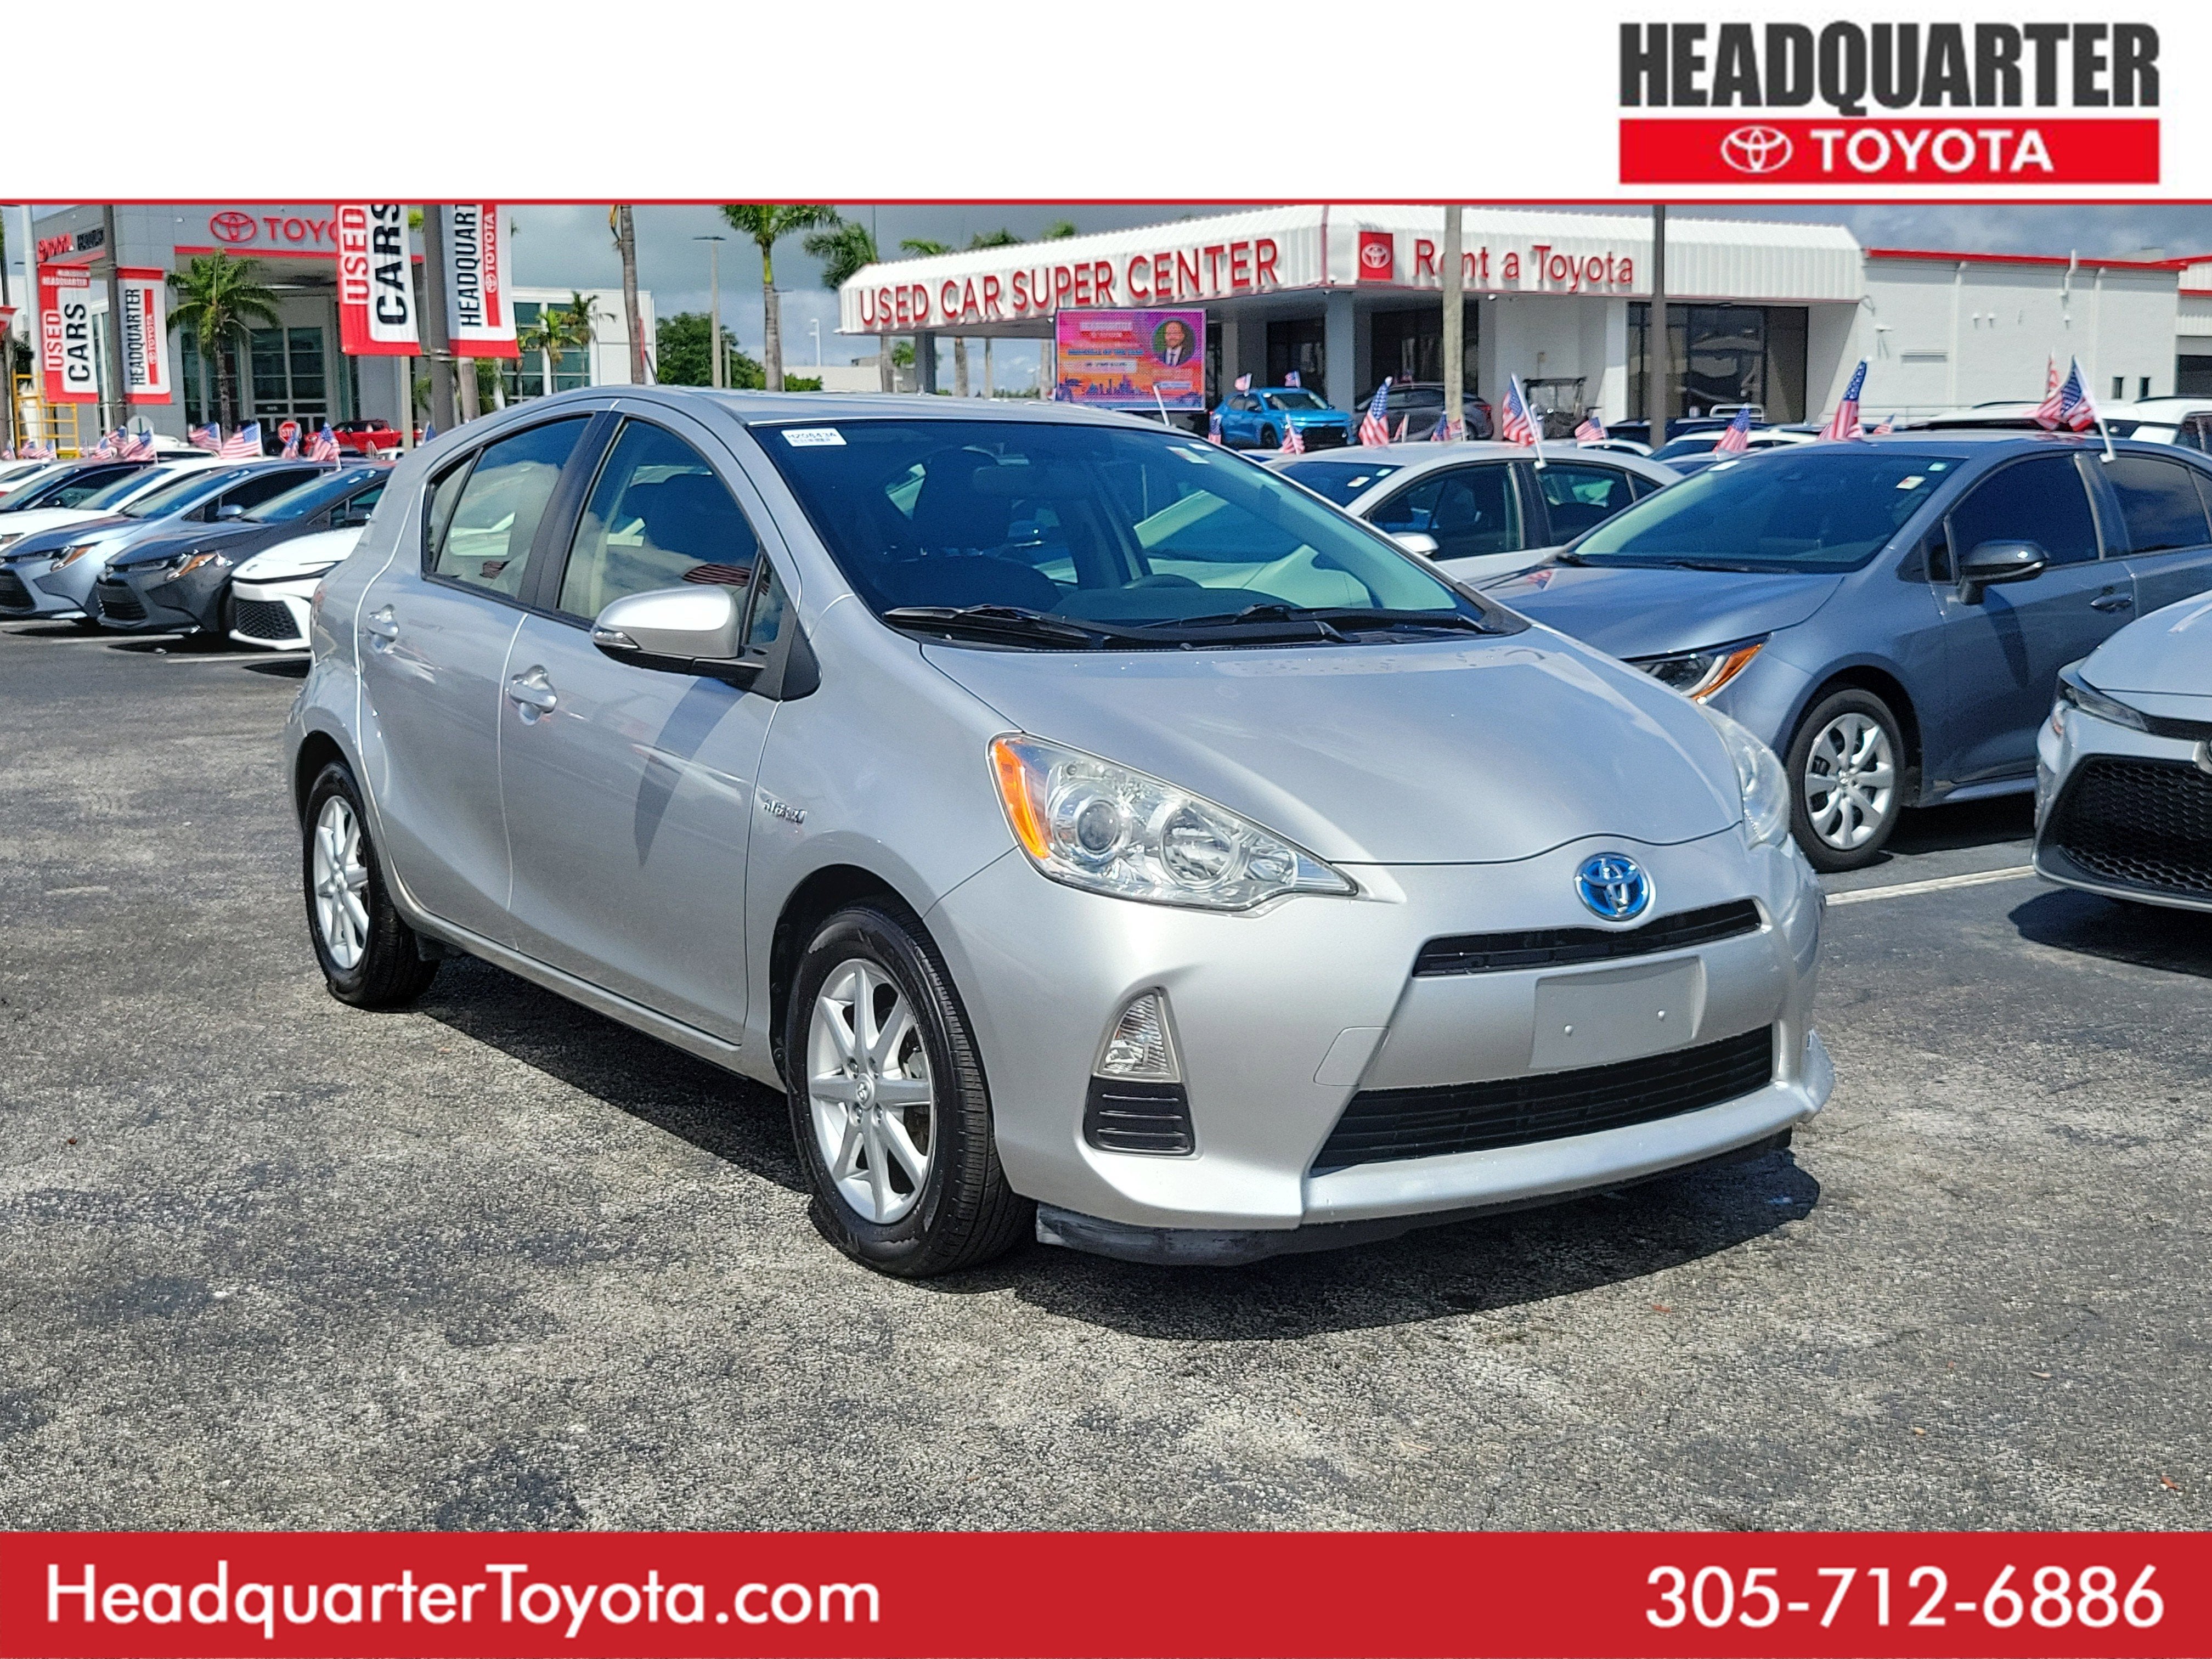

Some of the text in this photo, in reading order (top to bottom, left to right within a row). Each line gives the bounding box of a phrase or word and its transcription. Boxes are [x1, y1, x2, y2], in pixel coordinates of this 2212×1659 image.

[342, 207, 370, 303] USED
[371, 205, 407, 325] CARS
[484, 213, 496, 272] TOYOTA
[859, 238, 1279, 326] USED CAR SUPER CENTER
[1414, 238, 1633, 294] Rnt a Toyota
[45, 312, 65, 368] USED
[64, 303, 91, 382] CARS
[125, 289, 146, 386] HEADQUARTER
